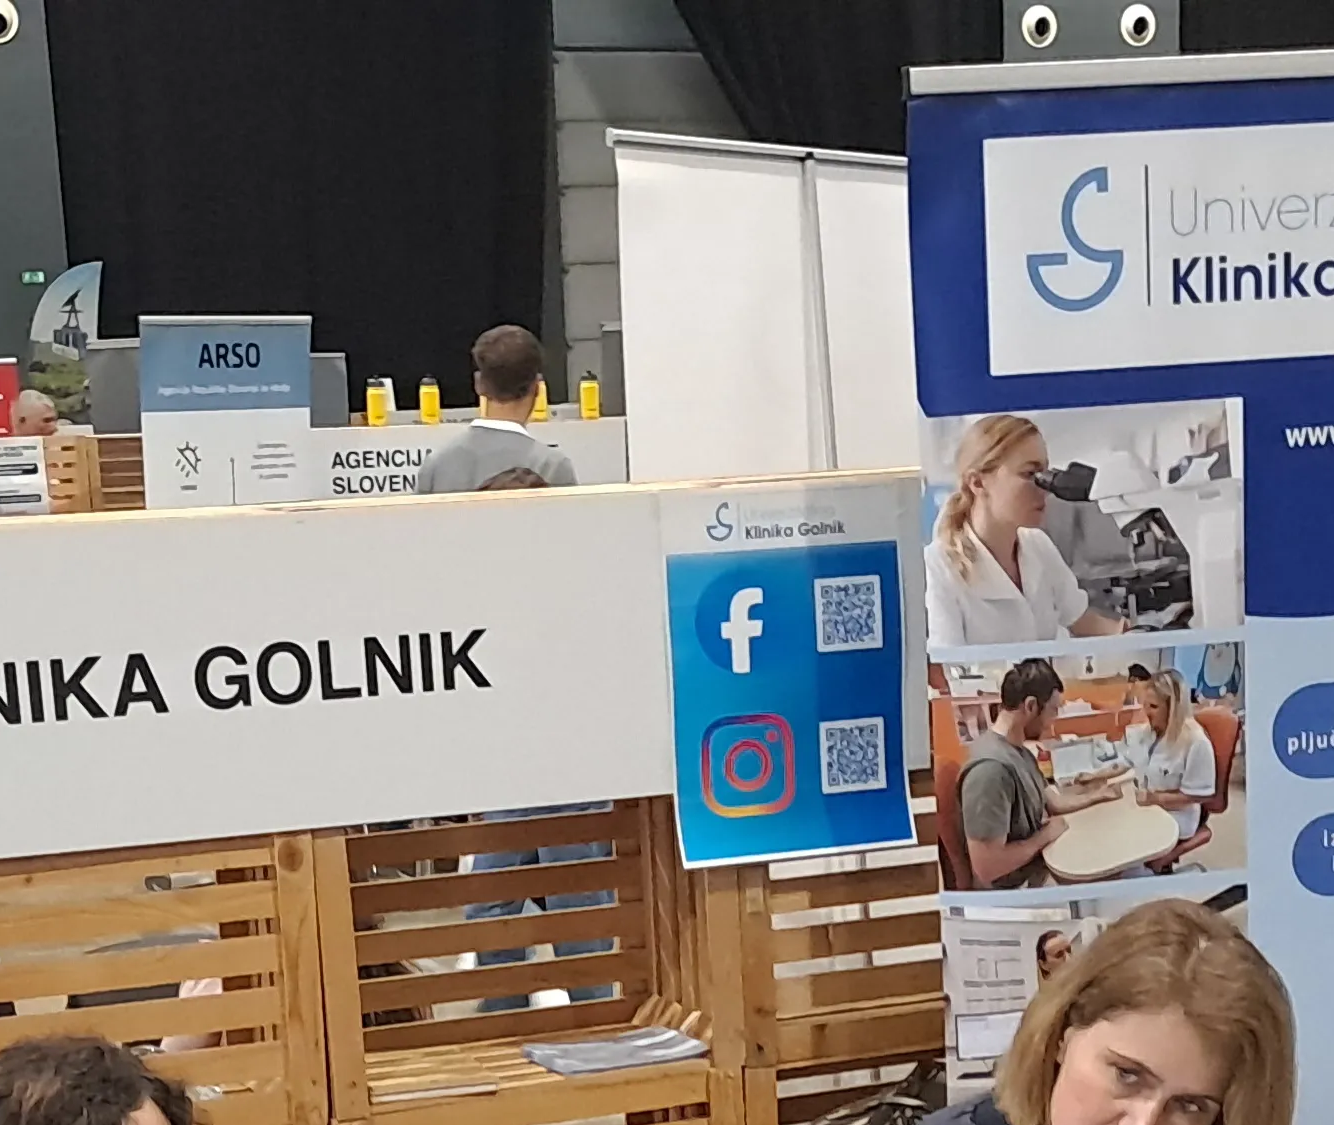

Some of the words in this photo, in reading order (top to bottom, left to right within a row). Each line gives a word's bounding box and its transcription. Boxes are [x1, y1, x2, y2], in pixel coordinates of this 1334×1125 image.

[198, 343, 261, 369] ARSO
[332, 449, 431, 470] AGENCIJ
[745, 523, 794, 540] Klinika
[195, 629, 492, 711] GOLNIK
